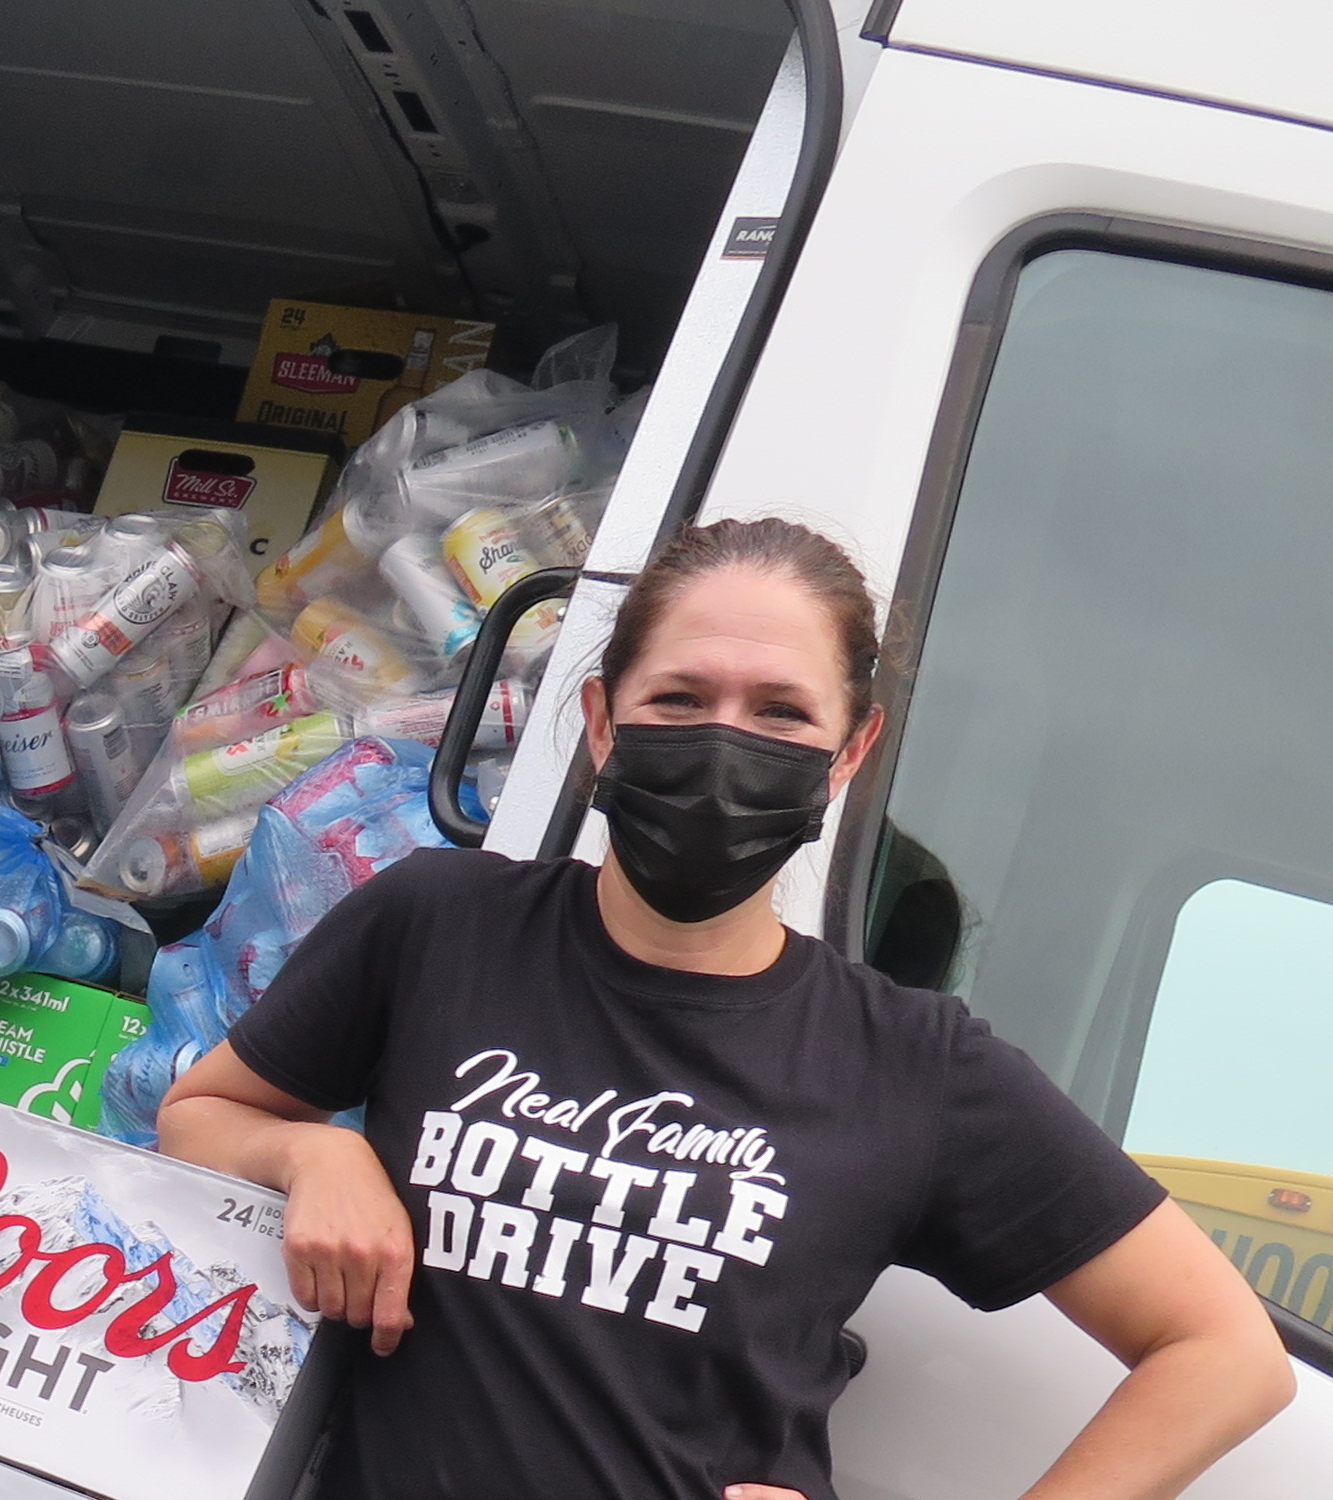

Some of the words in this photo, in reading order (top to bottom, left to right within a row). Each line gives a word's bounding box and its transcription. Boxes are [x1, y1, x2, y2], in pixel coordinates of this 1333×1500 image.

[257, 401, 348, 436] ORIGINAL
[175, 473, 219, 495] Mill
[450, 1047, 619, 1133] Neal
[602, 1090, 787, 1186] Family
[409, 1110, 789, 1268] BOTTLE
[216, 1197, 256, 1228] 24
[258, 1223, 275, 1238] DE
[421, 1190, 725, 1334] DRIVE
